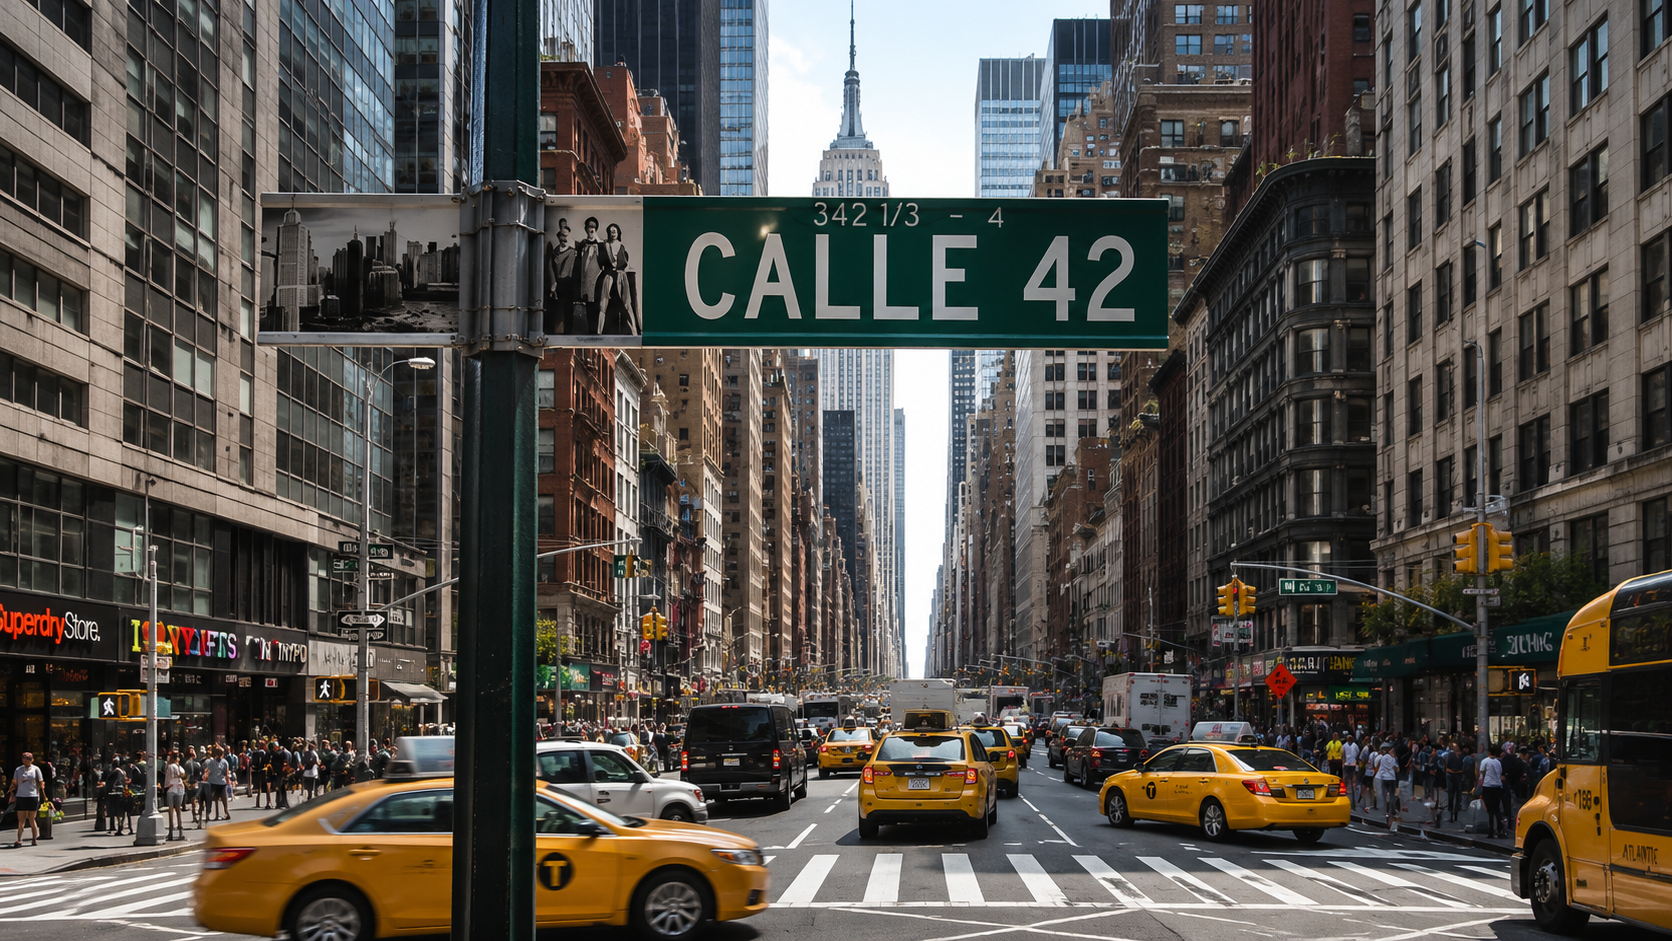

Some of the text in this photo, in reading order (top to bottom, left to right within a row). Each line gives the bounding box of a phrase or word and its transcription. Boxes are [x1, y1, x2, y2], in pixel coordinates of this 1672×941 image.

[813, 201, 868, 227] 342
[879, 202, 920, 228] 1/3
[987, 206, 1004, 228] 4
[684, 231, 1135, 322] CALLE 42
[543, 860, 568, 887] T
